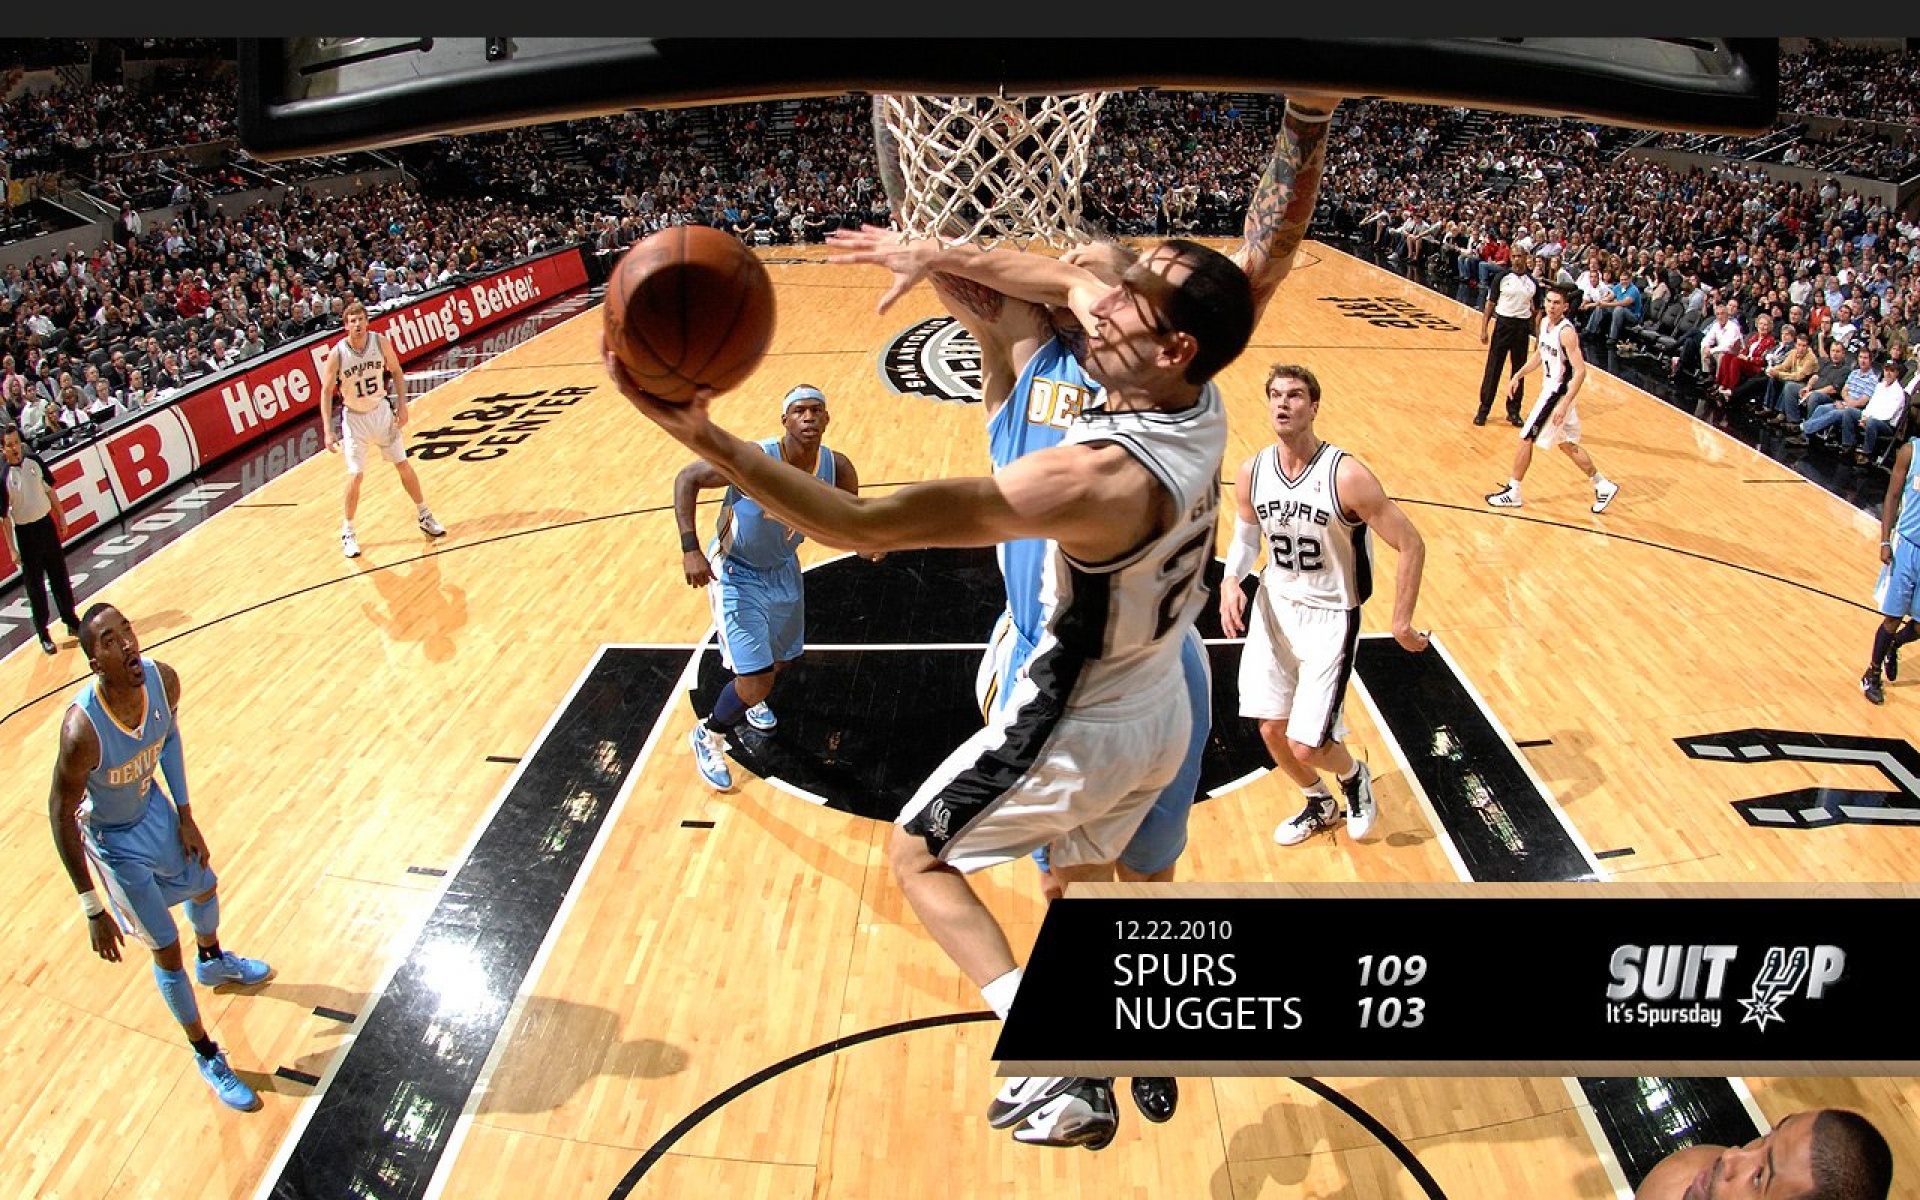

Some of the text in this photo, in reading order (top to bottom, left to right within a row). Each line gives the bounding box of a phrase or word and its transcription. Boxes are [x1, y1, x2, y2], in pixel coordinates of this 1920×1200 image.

[221, 368, 310, 435] Here
[354, 376, 379, 398] 15
[458, 386, 598, 461] CENTER
[1256, 500, 1330, 527] SPURS
[1269, 533, 1324, 571] 22
